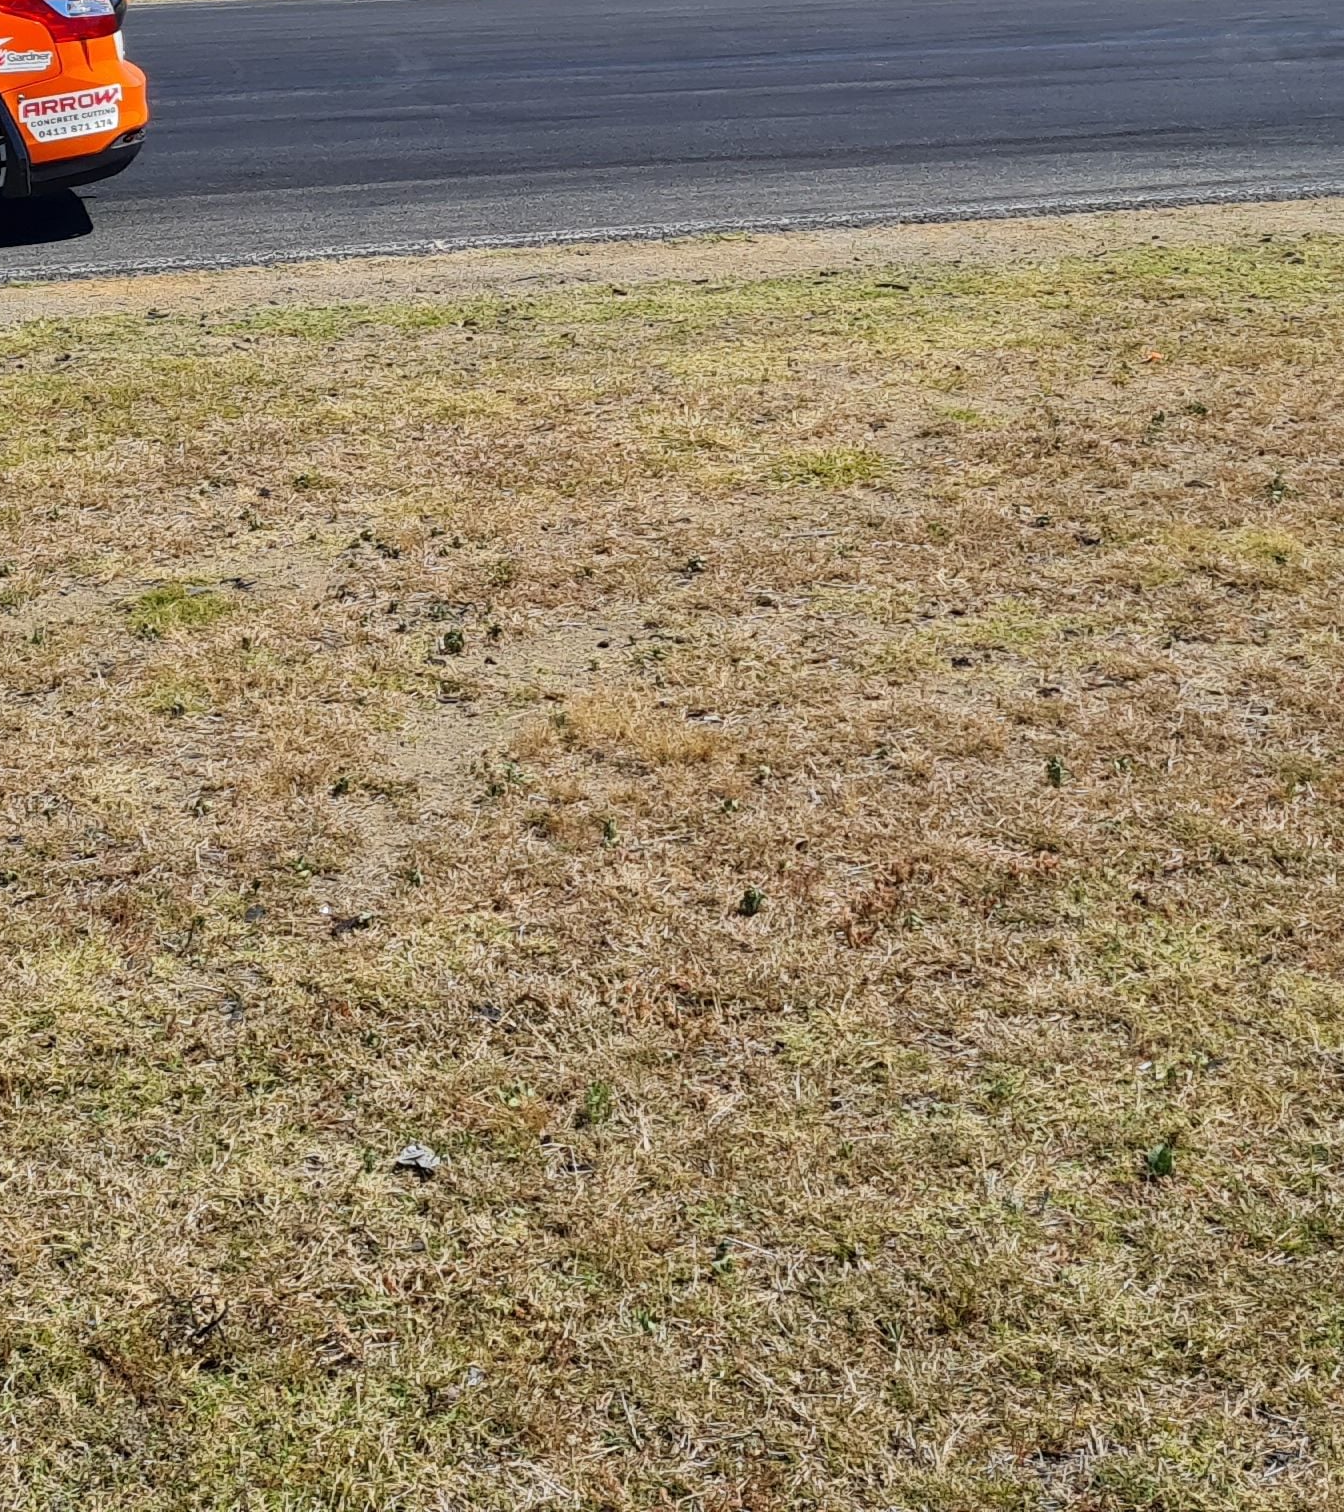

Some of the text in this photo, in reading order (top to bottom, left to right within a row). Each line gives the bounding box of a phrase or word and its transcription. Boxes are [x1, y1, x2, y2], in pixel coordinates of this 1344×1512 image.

[7, 52, 50, 63] Gardner
[22, 87, 120, 119] ARROW
[30, 107, 116, 128] CONCRETE CUTTING
[38, 117, 113, 138] 0413 871 174
